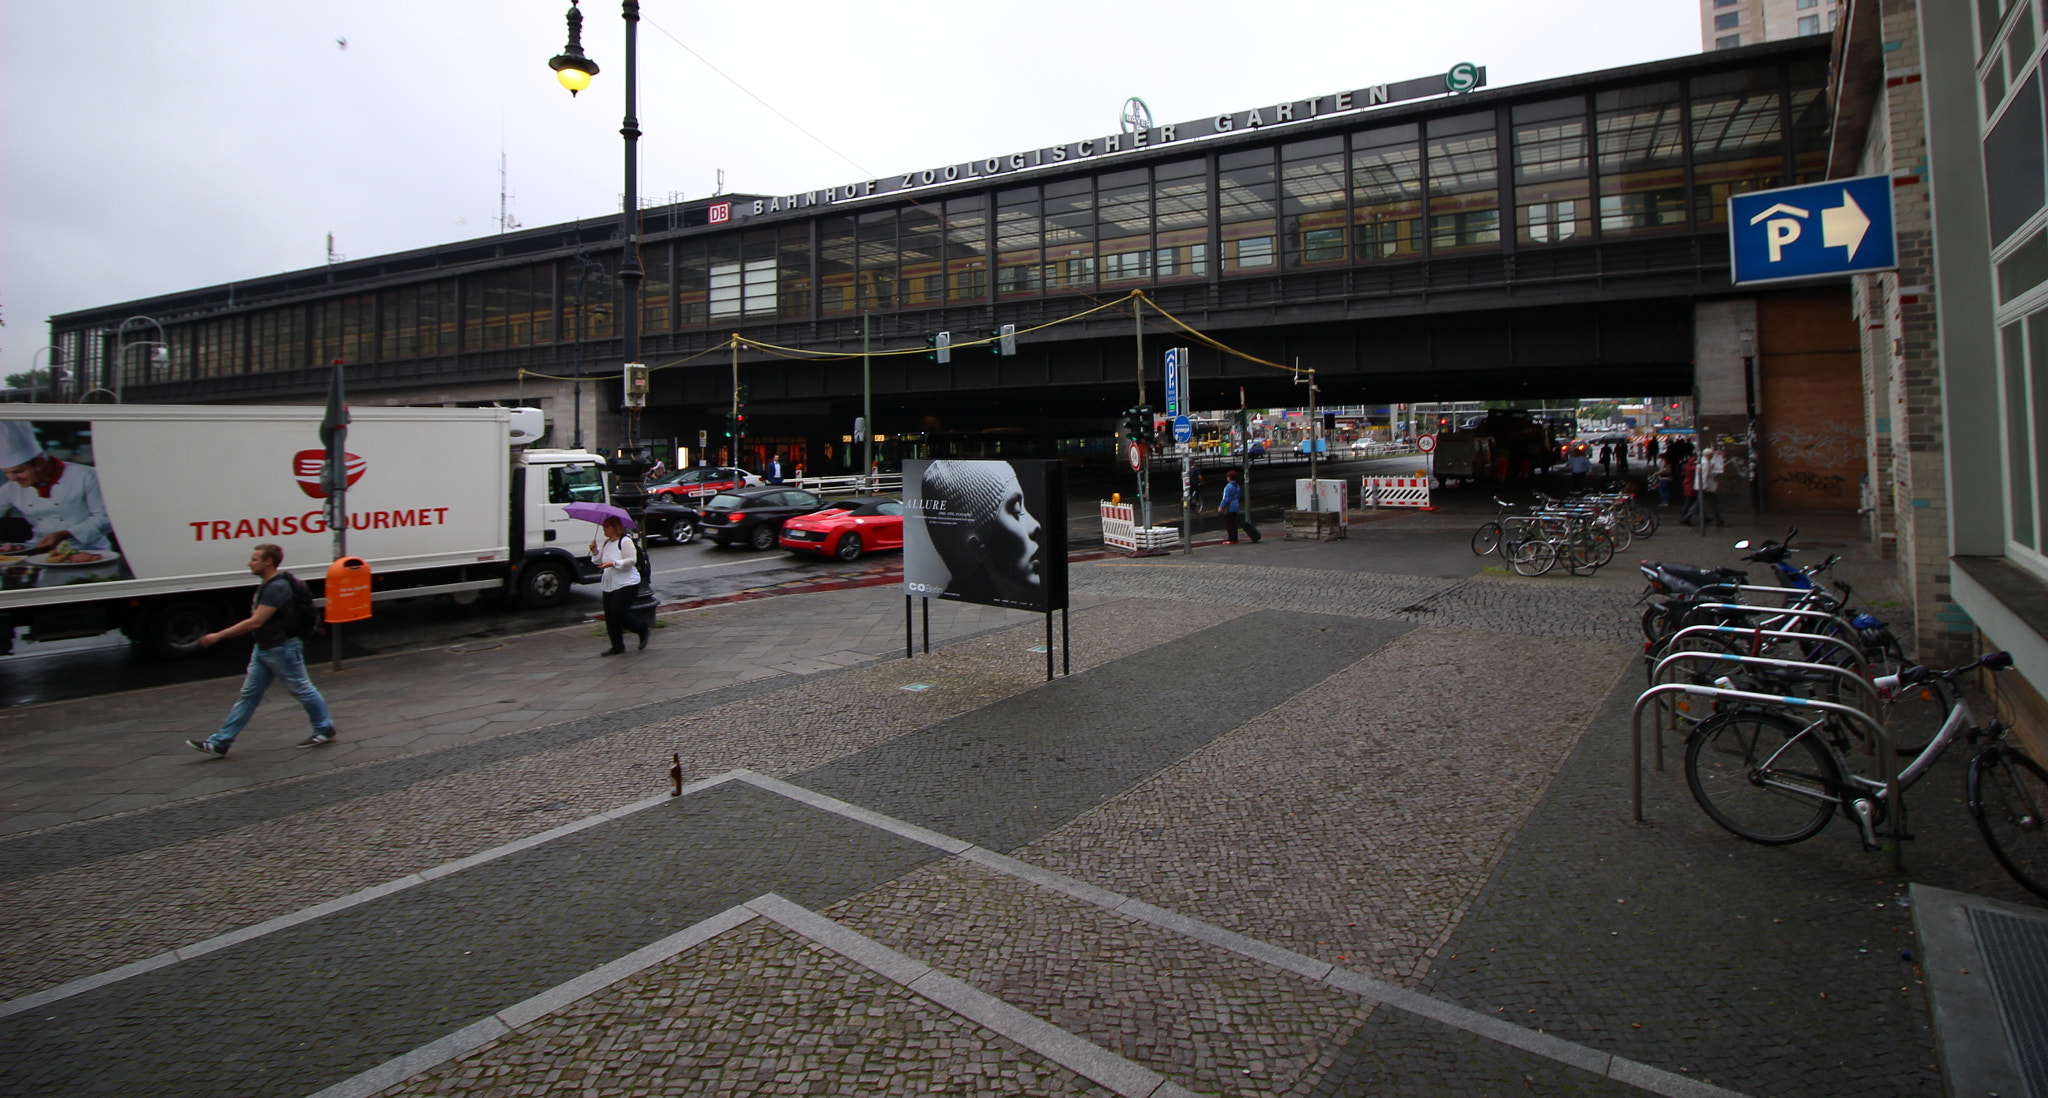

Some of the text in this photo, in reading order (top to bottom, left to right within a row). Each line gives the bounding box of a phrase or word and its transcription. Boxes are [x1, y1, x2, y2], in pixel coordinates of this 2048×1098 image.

[1452, 65, 1473, 89] S
[1126, 114, 1150, 128] BAYER
[753, 83, 1388, 215] BAHNHOF ZOOLOGISCHER GARTEN
[711, 206, 727, 222] DB
[1766, 217, 1802, 263] P
[905, 499, 947, 511] ALLURE
[189, 507, 449, 541] TRANSGURMET
